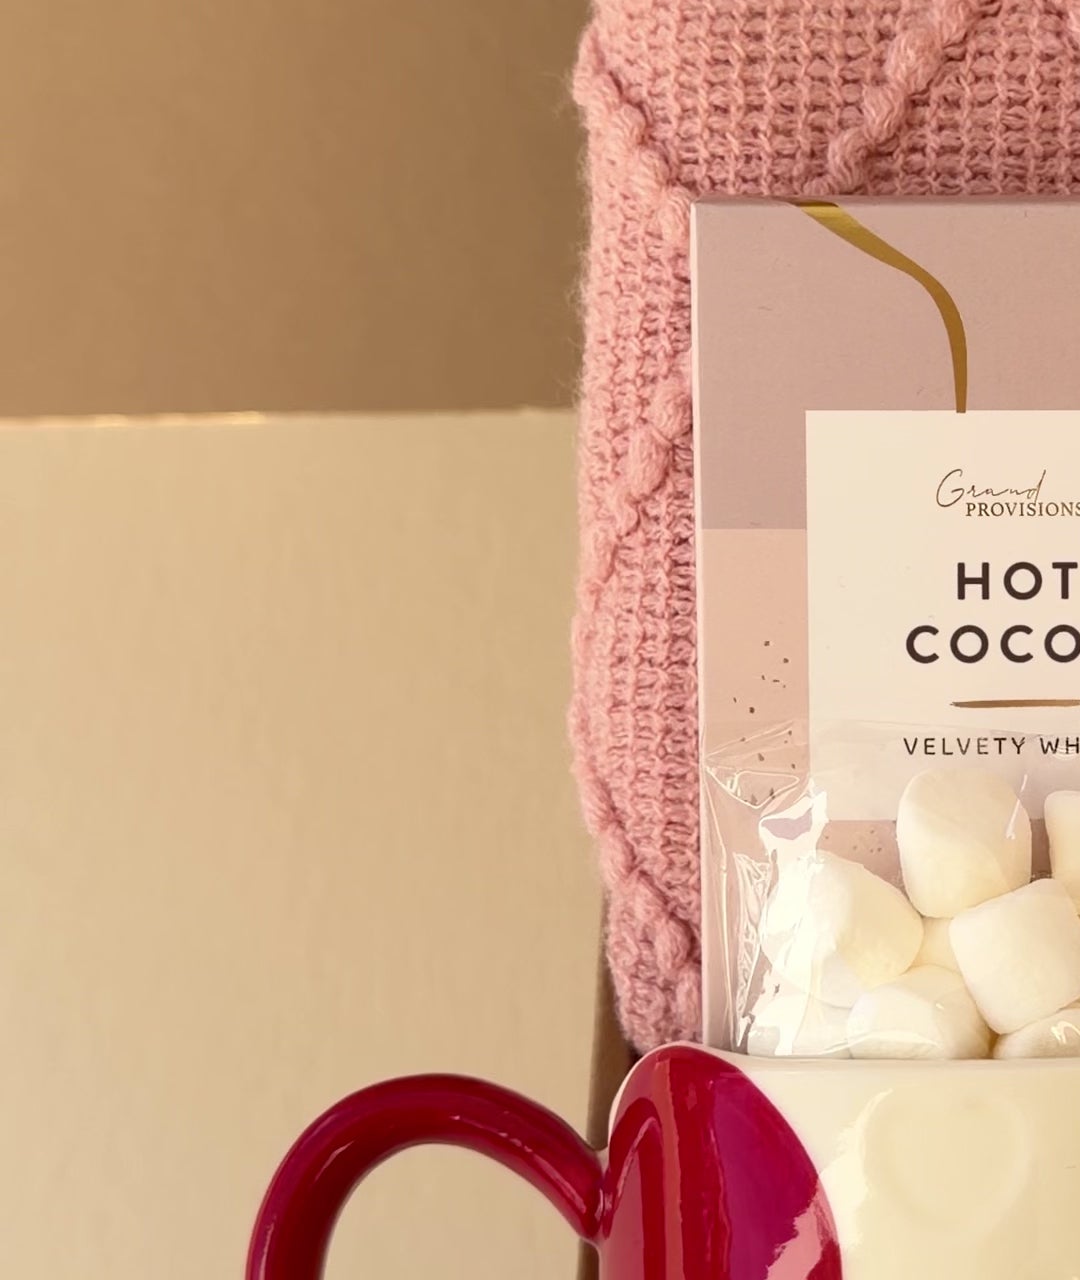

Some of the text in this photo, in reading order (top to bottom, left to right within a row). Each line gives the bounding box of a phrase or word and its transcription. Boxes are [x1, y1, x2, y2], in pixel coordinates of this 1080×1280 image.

[936, 468, 1046, 507] Grand
[957, 561, 1078, 600] HOT
[903, 737, 1026, 755] VELVETY
